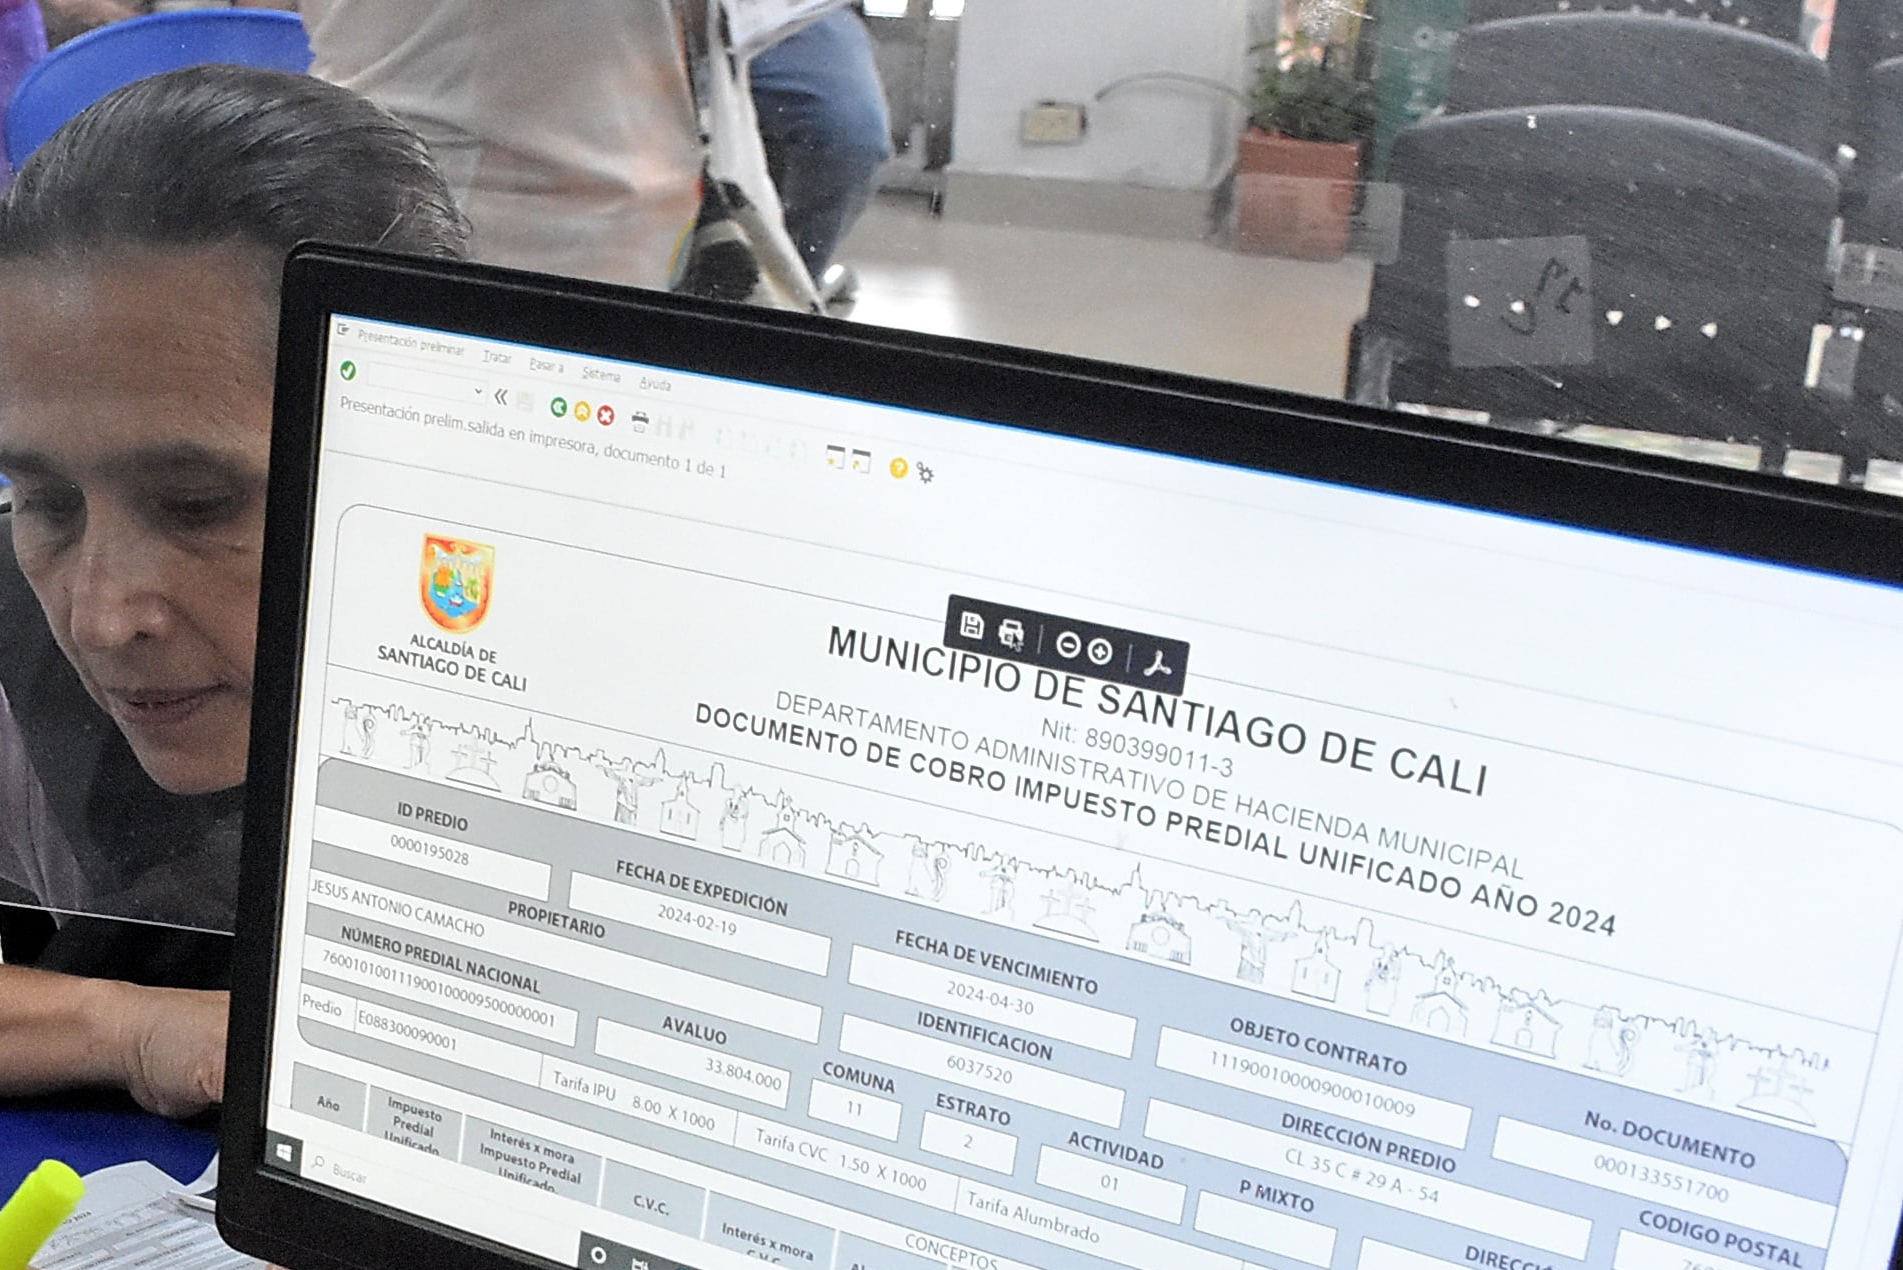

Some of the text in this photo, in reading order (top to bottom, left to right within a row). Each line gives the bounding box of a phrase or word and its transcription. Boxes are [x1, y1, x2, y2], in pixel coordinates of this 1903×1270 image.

[339, 394, 420, 422] Presentación
[507, 428, 526, 441] en
[528, 428, 599, 457] impresora,
[602, 442, 680, 470] documento
[685, 457, 691, 473] 1
[695, 459, 714, 476] de
[719, 464, 725, 479] 1
[377, 644, 527, 692] SANTIAGO DE CALI
[409, 633, 497, 664] ALCALDÍA DE
[827, 624, 1487, 797] MUNICIPIO DE SANTIAGO DE CALI
[1041, 716, 1233, 778] Nit: 890399011-3
[775, 689, 1523, 880] DEPARTAMENTO ADMINISTRATIVO DE HACIENDA MUNICIPAL
[397, 801, 468, 832] ID PREDIO
[695, 701, 1615, 937] DOCUMENTO DE COBRO IMPUESTO PREDIAL UNIFICADO AÑO 2024
[389, 833, 469, 866] 0000195028
[615, 858, 788, 917] FECHA DE EXPEDICIÓN
[310, 878, 485, 938] JESUS ANTONIO CAMACHO
[507, 899, 605, 938] PROPIETARIO
[657, 903, 737, 936] 2024-02-19
[340, 924, 540, 994] NÚMERO PREDIAL NACIONAL
[894, 928, 1098, 995] FECHA DE VENCIMIENTO
[301, 992, 342, 1017] Predio
[322, 948, 554, 1027] 760010100111900100009500000001
[946, 979, 1034, 1015] 2024-04-30
[357, 1008, 456, 1051] E088300090001
[661, 1015, 727, 1045] AVALUO
[916, 1010, 1053, 1061] IDENTIFICACION
[1229, 1016, 1408, 1076] OBJETO CONTRATO
[553, 1069, 616, 1101] Tarifa IPU
[704, 1056, 782, 1091] 33.804.000
[822, 1060, 895, 1094] COMUNA
[946, 1054, 1013, 1084] 6037520
[1211, 1050, 1416, 1118] 11190010000900010009
[387, 1095, 442, 1122] Impuesto
[392, 1114, 434, 1138] Predial
[631, 1094, 715, 1131] 8.00 X 1000
[847, 1099, 862, 1116] 11
[935, 1092, 1011, 1126] ESTRATO
[489, 1126, 575, 1164] Interés x mora
[756, 1126, 828, 1162] Tarifa CVC
[962, 1133, 973, 1149] 2
[1067, 1130, 1164, 1170] ACTIVIDAD
[1280, 1111, 1456, 1173] DIRECCIÓN PREDIO
[1583, 1109, 1756, 1169] No. DOCUMENTO
[332, 1162, 367, 1184] Buscar
[479, 1141, 581, 1184] Impuesto Predial
[840, 1153, 927, 1192] 1.50 X 1000
[1099, 1173, 1118, 1191] 01
[1284, 1147, 1304, 1167] CL
[1310, 1154, 1331, 1173] 35
[1334, 1161, 1347, 1178] C
[1364, 1170, 1387, 1189] 29
[1389, 1177, 1402, 1194] A
[1417, 1185, 1439, 1203] 54
[1593, 1153, 1729, 1203] 000133551700
[632, 1194, 669, 1216] C.V.C.
[1238, 1178, 1315, 1213] P MIXTO
[967, 1189, 1100, 1244] Tarifa Alumbrado
[721, 1221, 766, 1246] Interés
[768, 1239, 777, 1250] x
[778, 1242, 814, 1261] mora
[1638, 1209, 1803, 1269] CODIGO POSTAL
